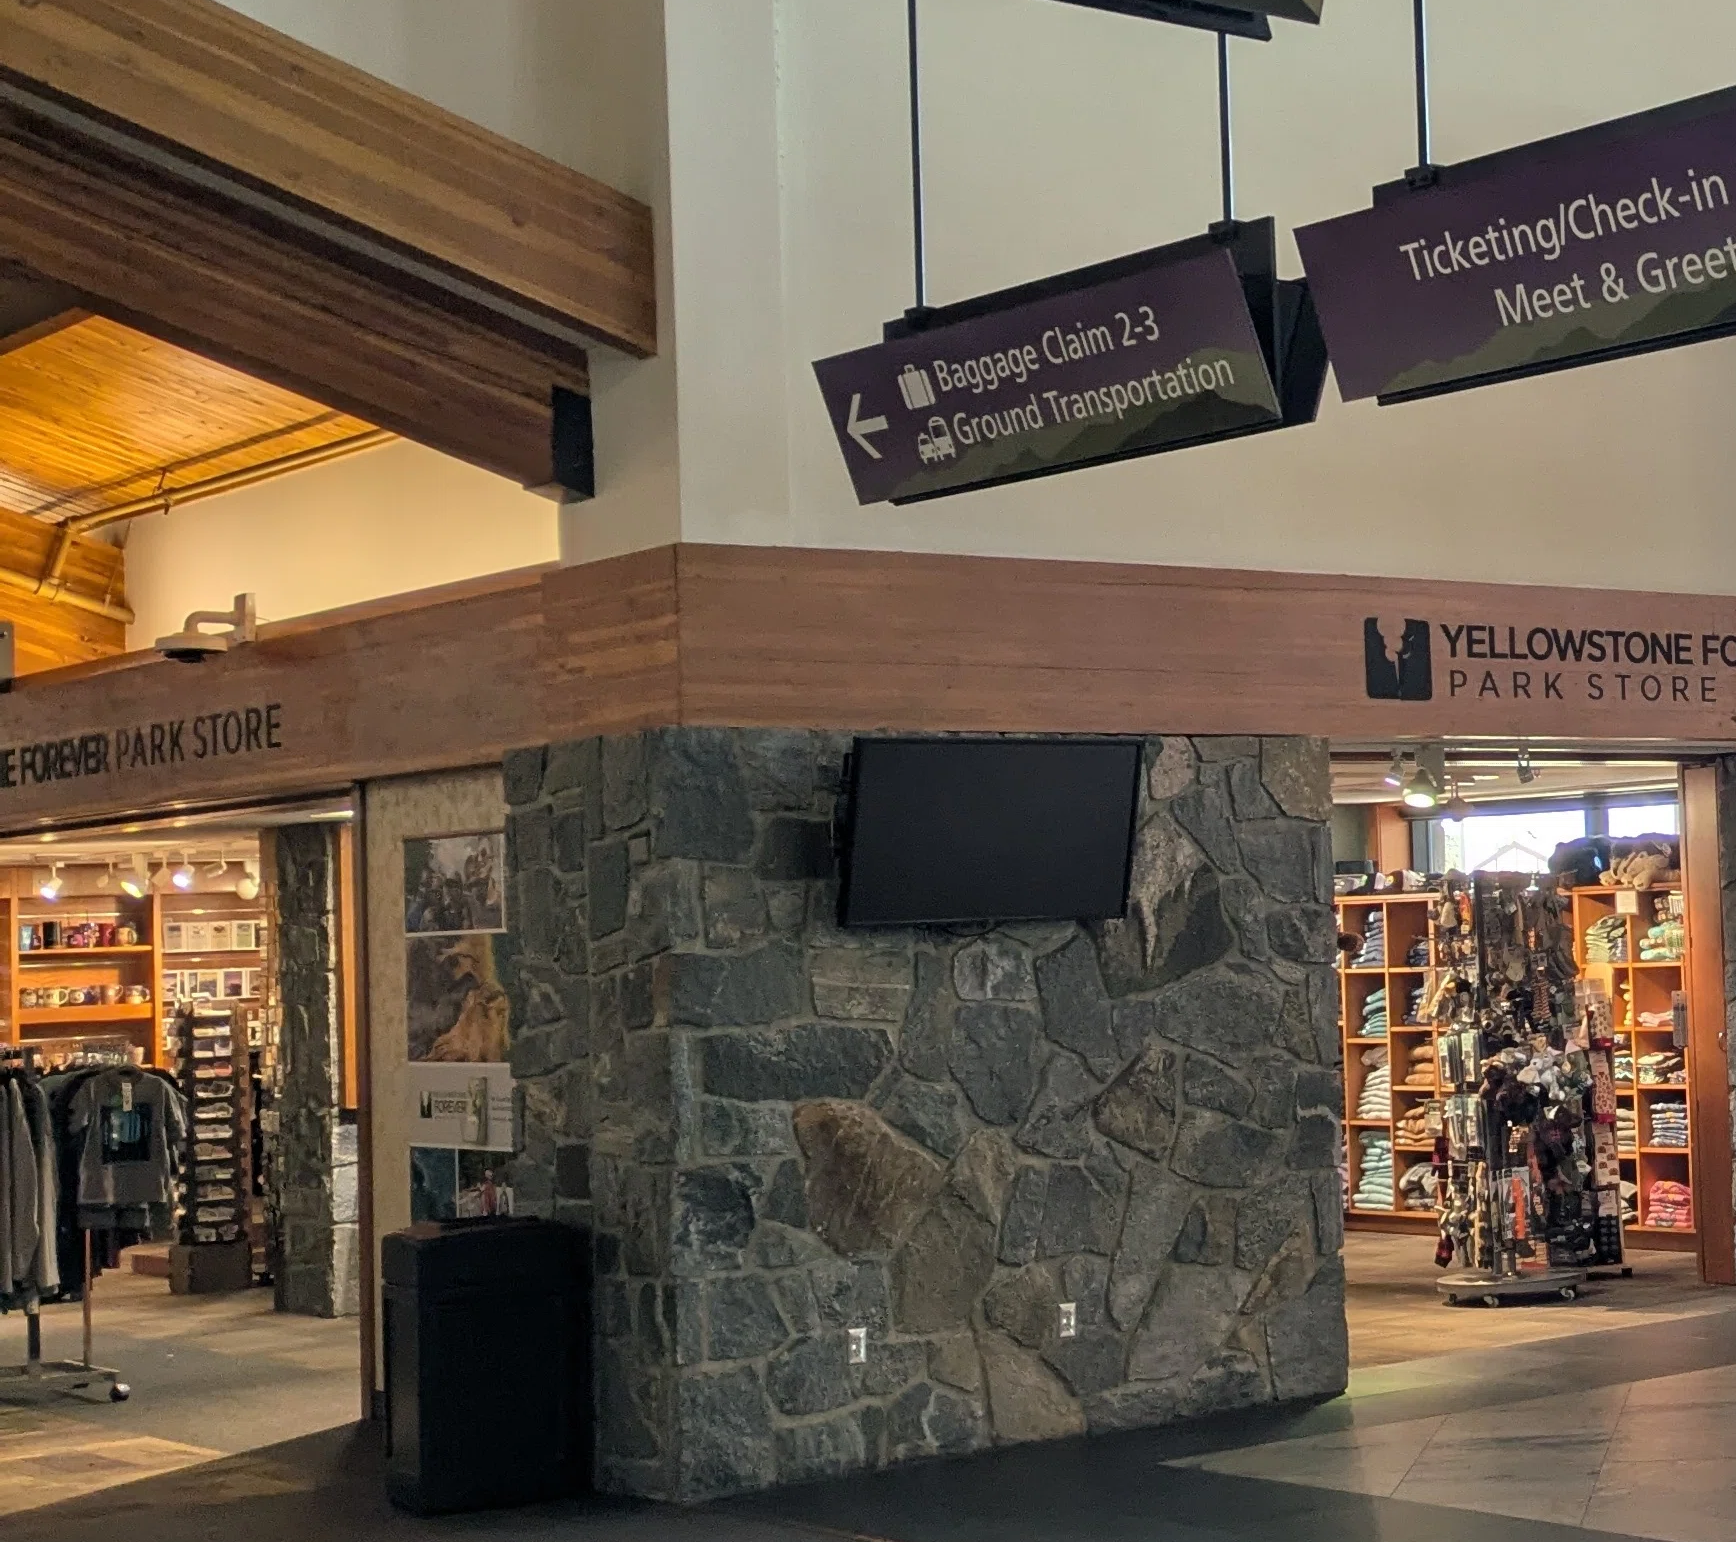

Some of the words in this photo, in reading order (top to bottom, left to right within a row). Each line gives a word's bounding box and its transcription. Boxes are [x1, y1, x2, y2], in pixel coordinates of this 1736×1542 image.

[1399, 168, 1730, 281] Ticketing/Check-in
[1493, 272, 1592, 327] Meet
[1599, 262, 1630, 303] &
[932, 344, 1041, 394] Baggage
[1041, 322, 1115, 365] Claim
[1114, 305, 1161, 347] 2-3
[952, 393, 1045, 446] Ground
[1042, 357, 1236, 425] Transportation
[1440, 622, 1694, 666] YELLOWSTONE
[1449, 669, 1563, 699] PARK
[1587, 673, 1718, 704] STORE
[20, 731, 111, 786] FOREVER
[115, 719, 186, 771] PARK
[192, 702, 282, 760] STORE
